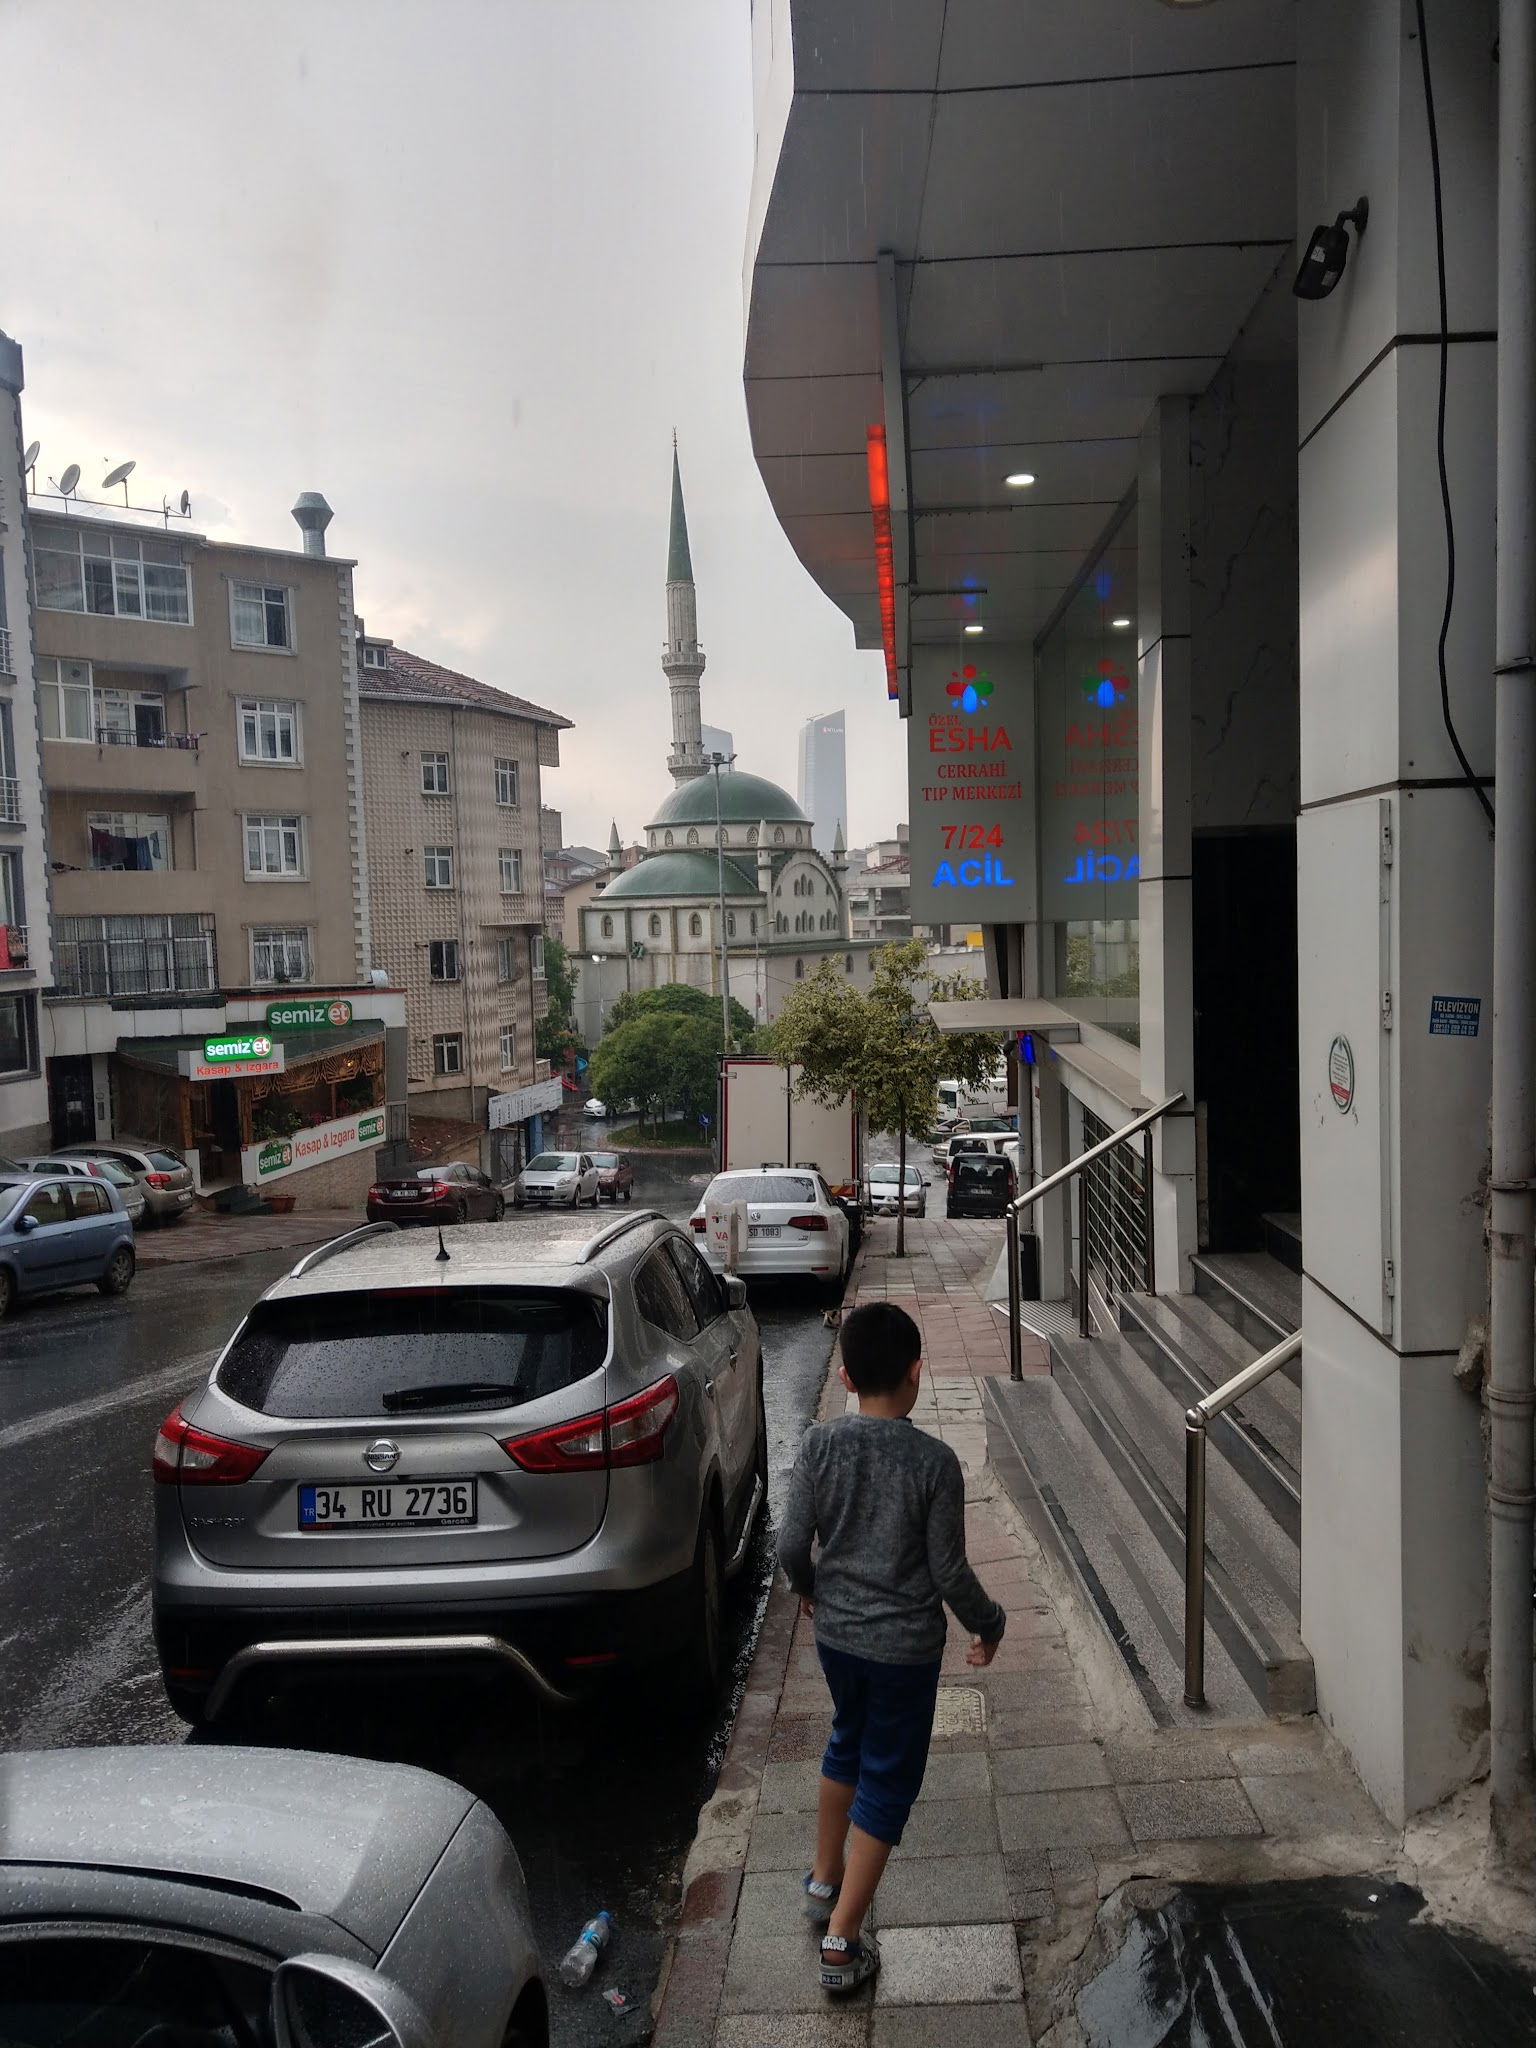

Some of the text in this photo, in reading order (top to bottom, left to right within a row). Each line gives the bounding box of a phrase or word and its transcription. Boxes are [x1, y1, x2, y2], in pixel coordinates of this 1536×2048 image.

[929, 726, 1013, 752] ESHA
[937, 760, 1006, 778] CERRAHİ
[921, 781, 1022, 801] TIP MERKEZİ
[941, 823, 1004, 849] 7/24
[932, 852, 1015, 888] ACİL
[271, 1002, 349, 1025] semiz et
[1433, 1000, 1479, 1014] TELEVİZYON
[206, 1037, 270, 1056] semiz et
[196, 1061, 279, 1077] Kasap & Izgara
[358, 1121, 377, 1137] semiz
[295, 1127, 355, 1158] Kasap & Izgara
[259, 1151, 281, 1170] semiz
[304, 1486, 467, 1519] TR 34 RU 2736
